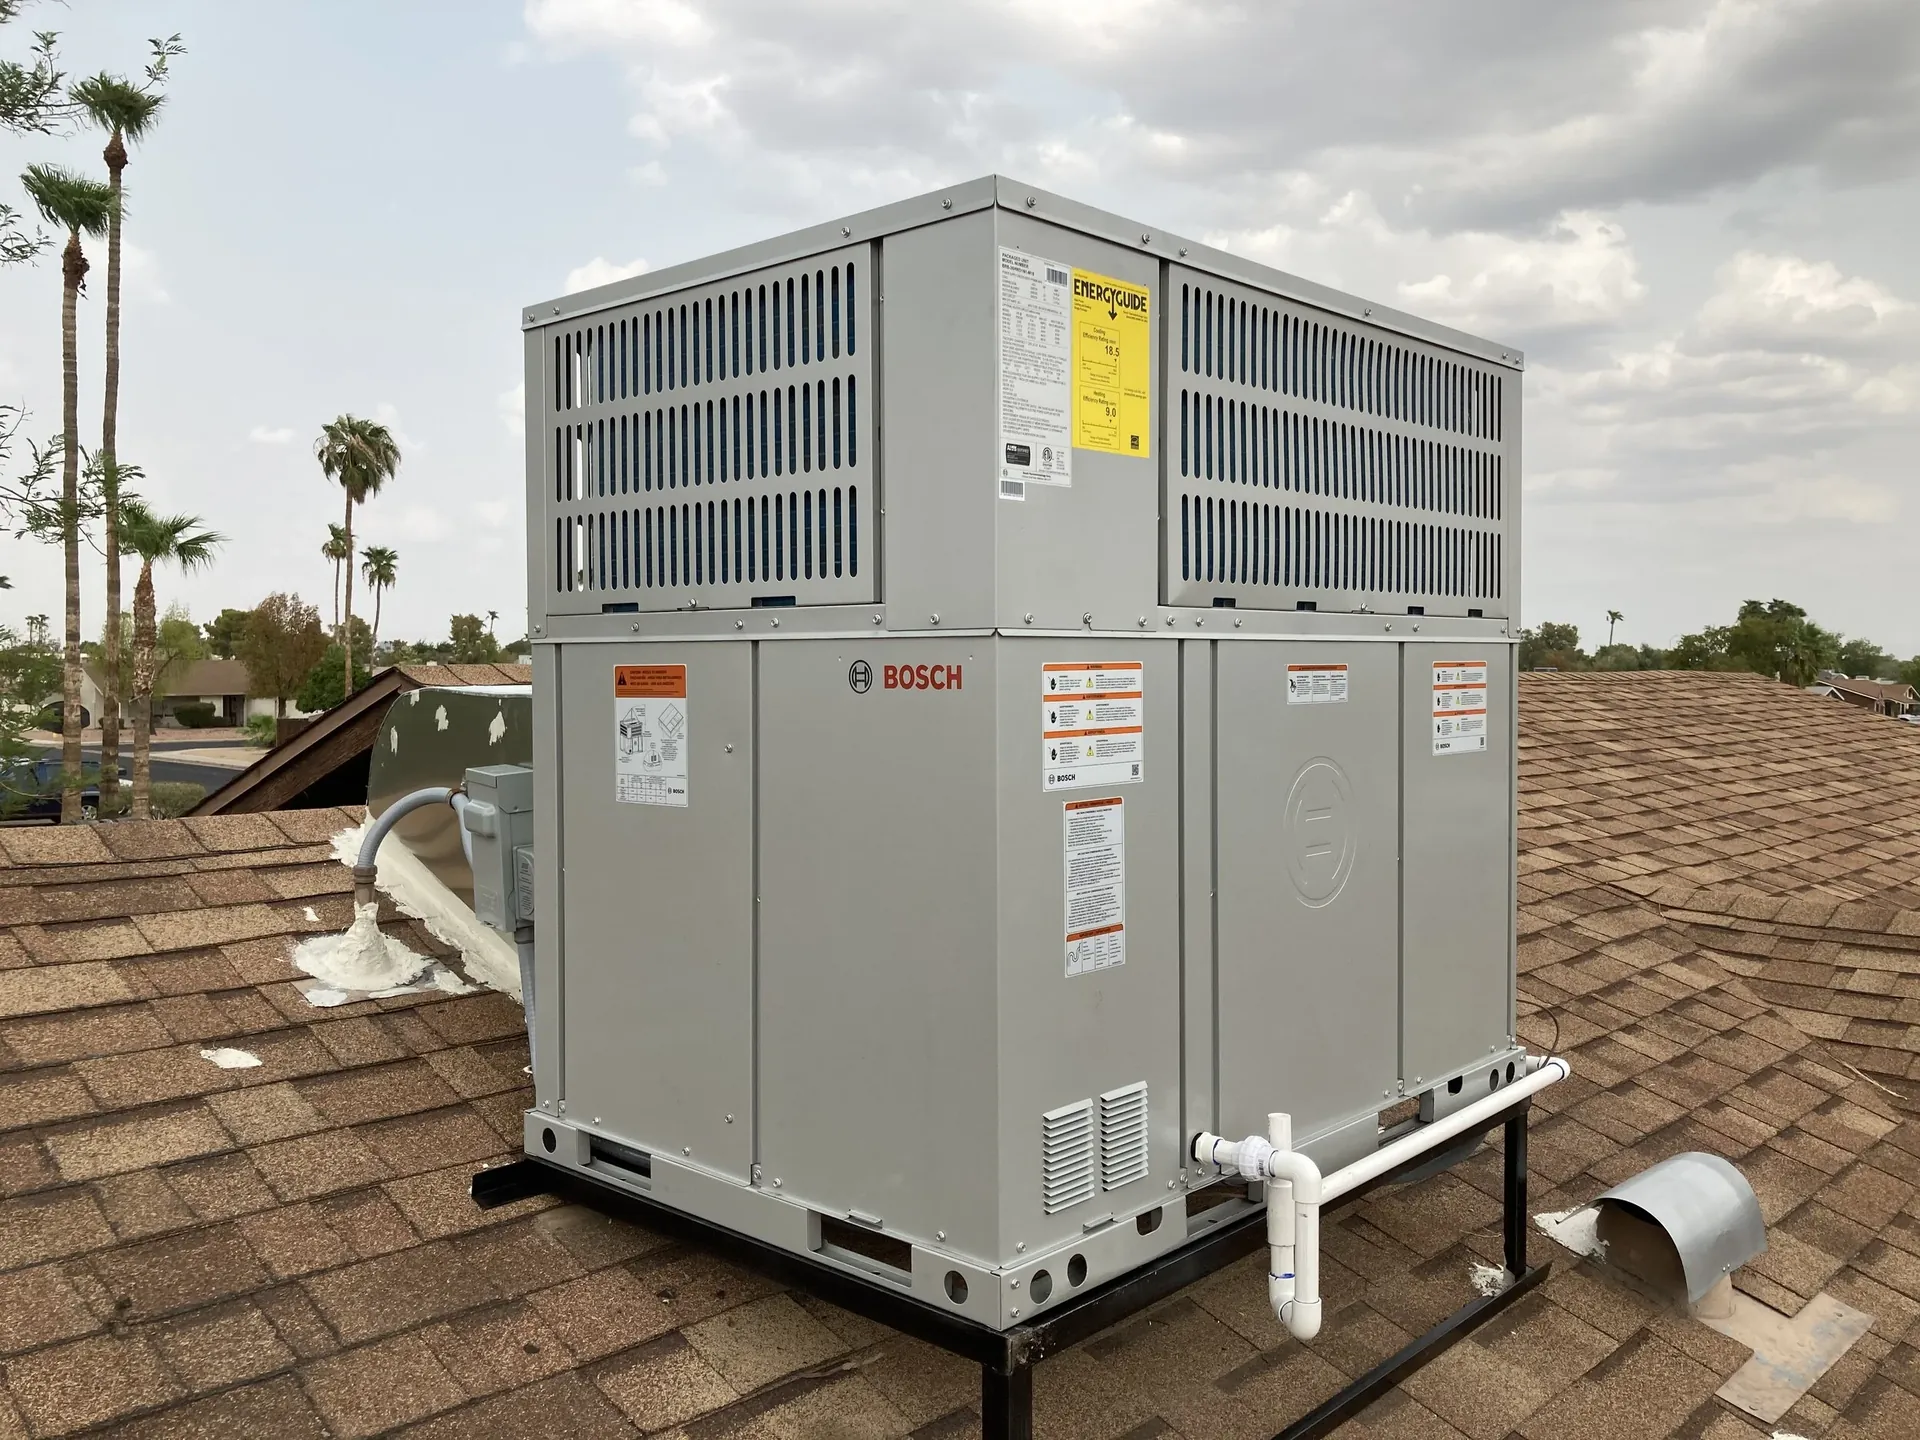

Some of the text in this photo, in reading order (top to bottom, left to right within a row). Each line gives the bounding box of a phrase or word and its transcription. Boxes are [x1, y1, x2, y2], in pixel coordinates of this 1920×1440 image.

[1074, 278, 1147, 313] ENERGYGUIDE
[1093, 327, 1106, 336] Cooling
[1083, 332, 1098, 341] Efficiency
[1099, 336, 1109, 344] Rating
[1105, 345, 1120, 357] 18.5
[1083, 395, 1098, 404] Efficiency
[1099, 398, 1109, 406] Rating
[1093, 391, 1106, 399] Heating
[1105, 406, 1117, 418] 9.0
[883, 664, 963, 690] BOSCH
[1057, 774, 1076, 782] BOSCH
